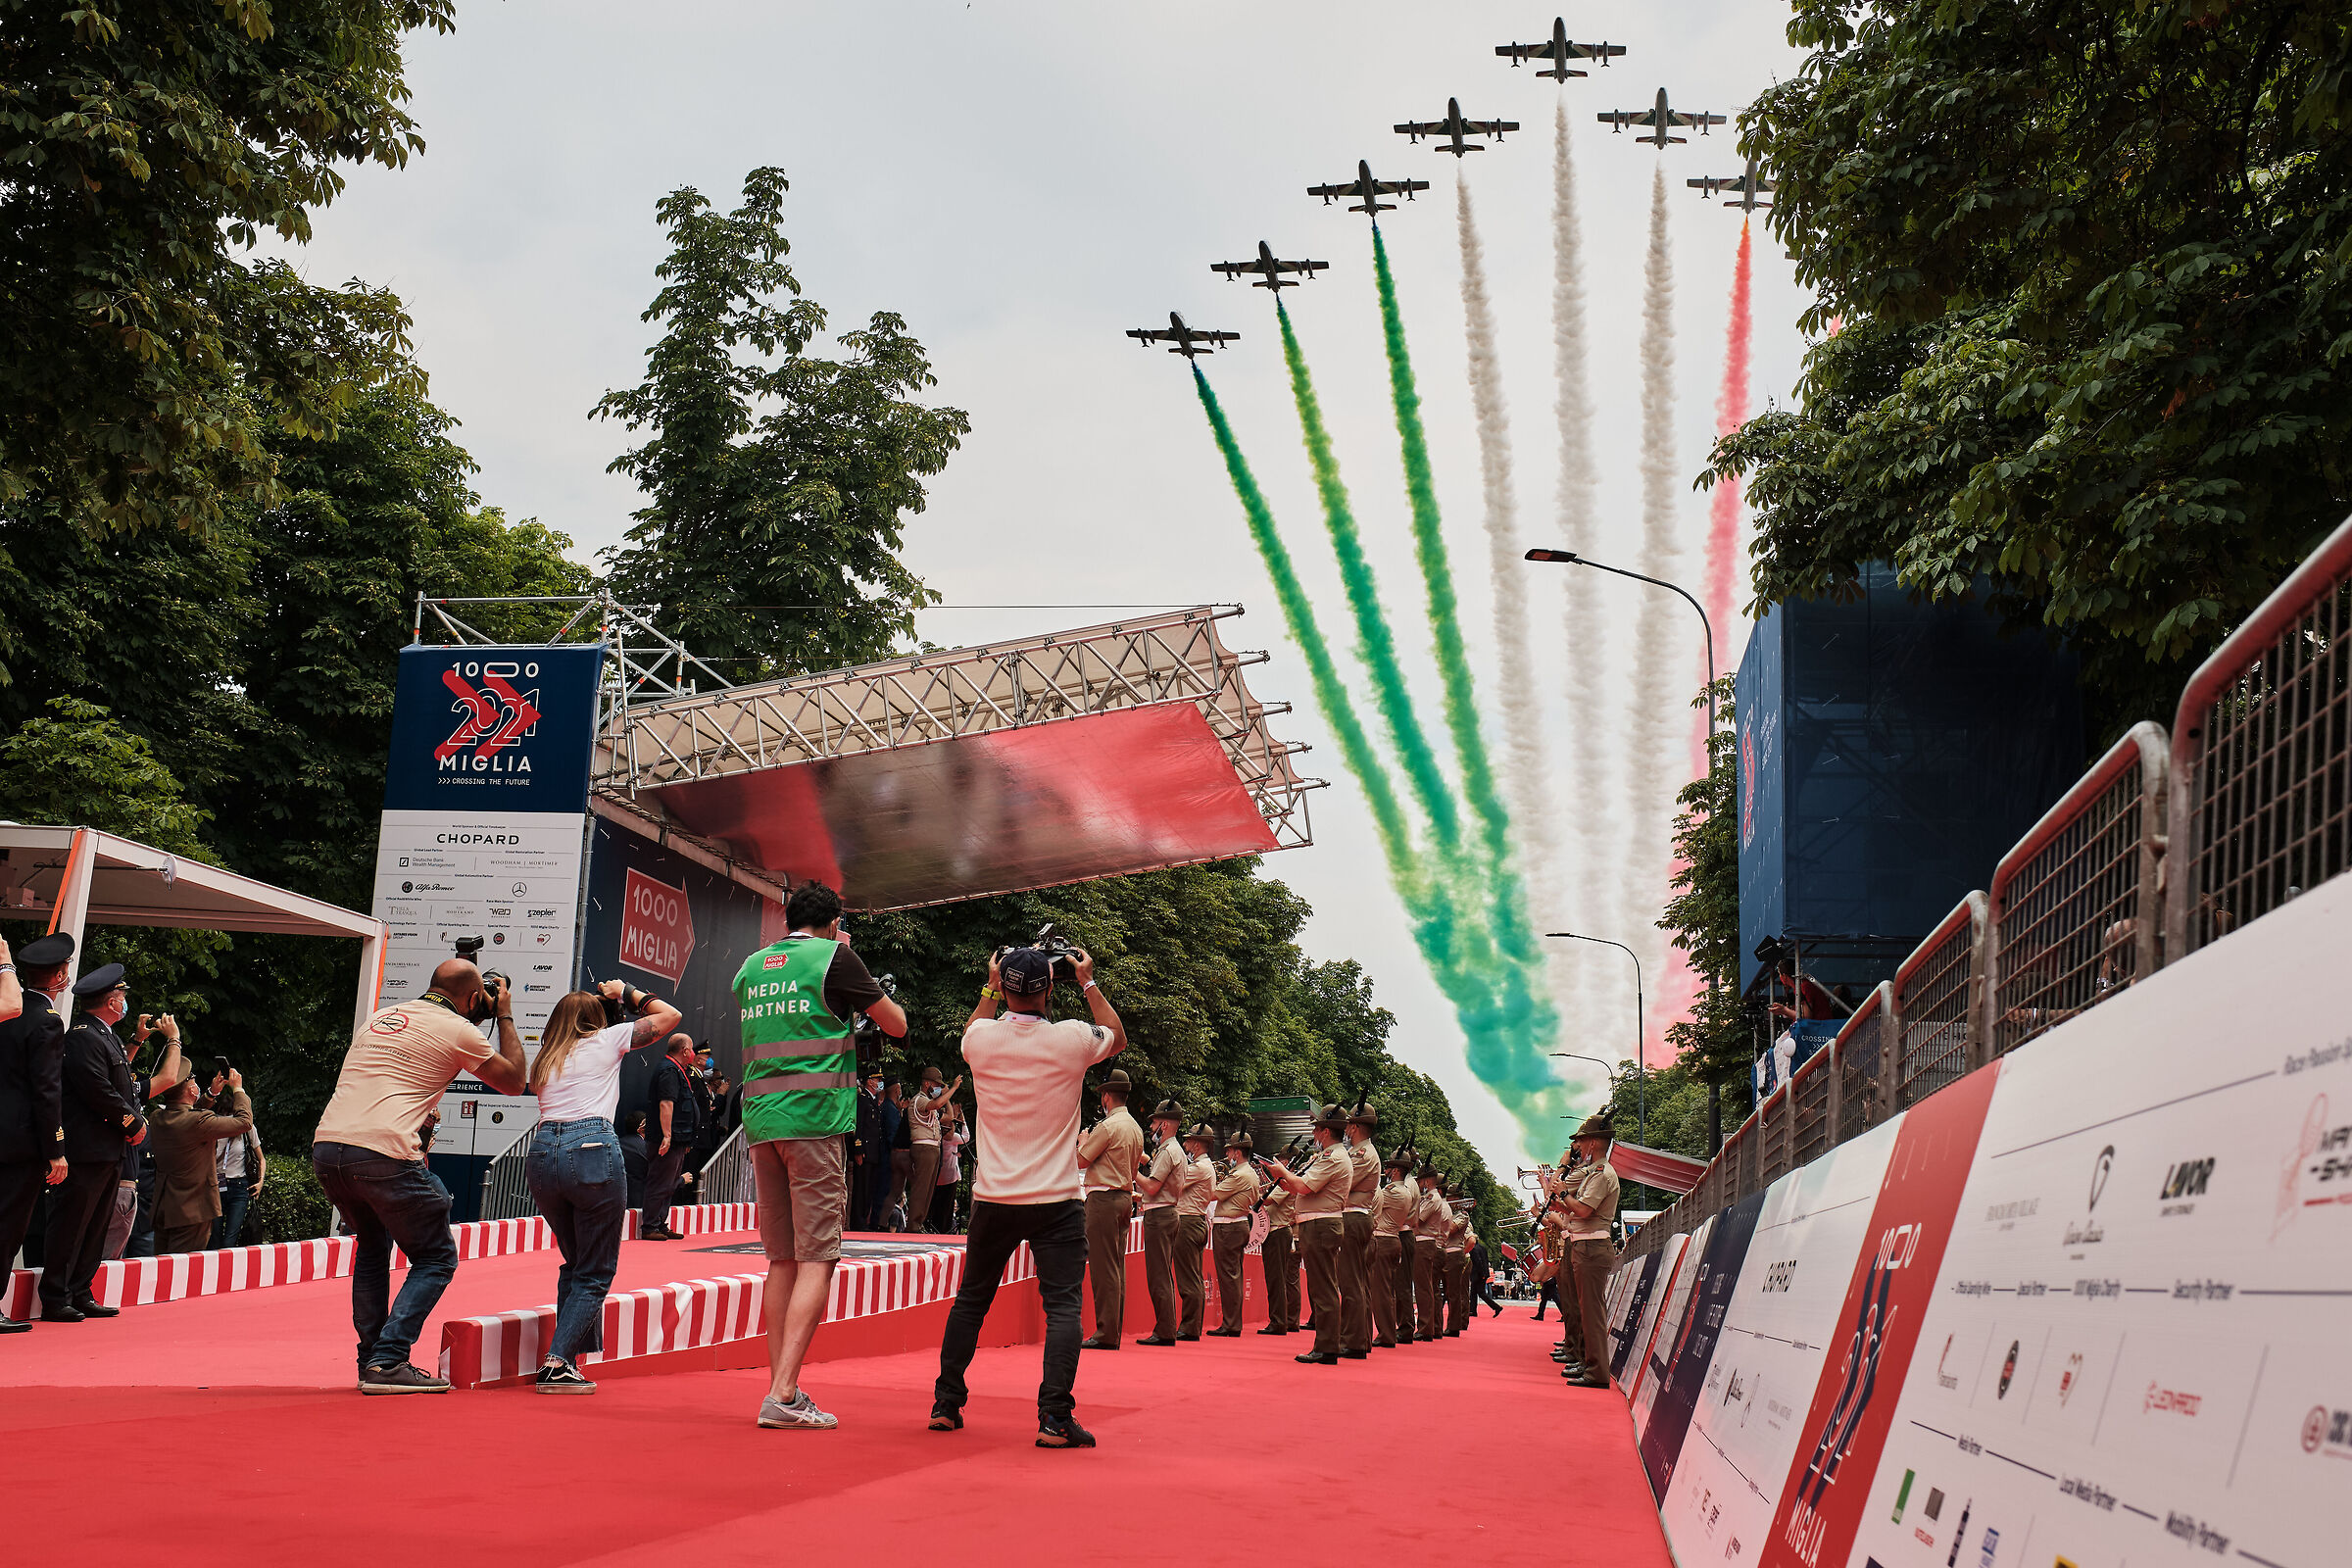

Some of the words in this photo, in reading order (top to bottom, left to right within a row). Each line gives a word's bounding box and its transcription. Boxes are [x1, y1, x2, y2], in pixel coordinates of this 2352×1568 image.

[452, 662, 539, 677] 1000
[447, 688, 540, 747] 2021
[438, 755, 532, 772] MIGLIA
[436, 833, 519, 845] CHOPARD
[633, 884, 678, 926] 1000
[625, 925, 677, 970] MIGLIA
[747, 979, 798, 1001] MEDIA
[741, 999, 810, 1022] PARTNER
[1785, 1496, 1827, 1568] MIGLIA
